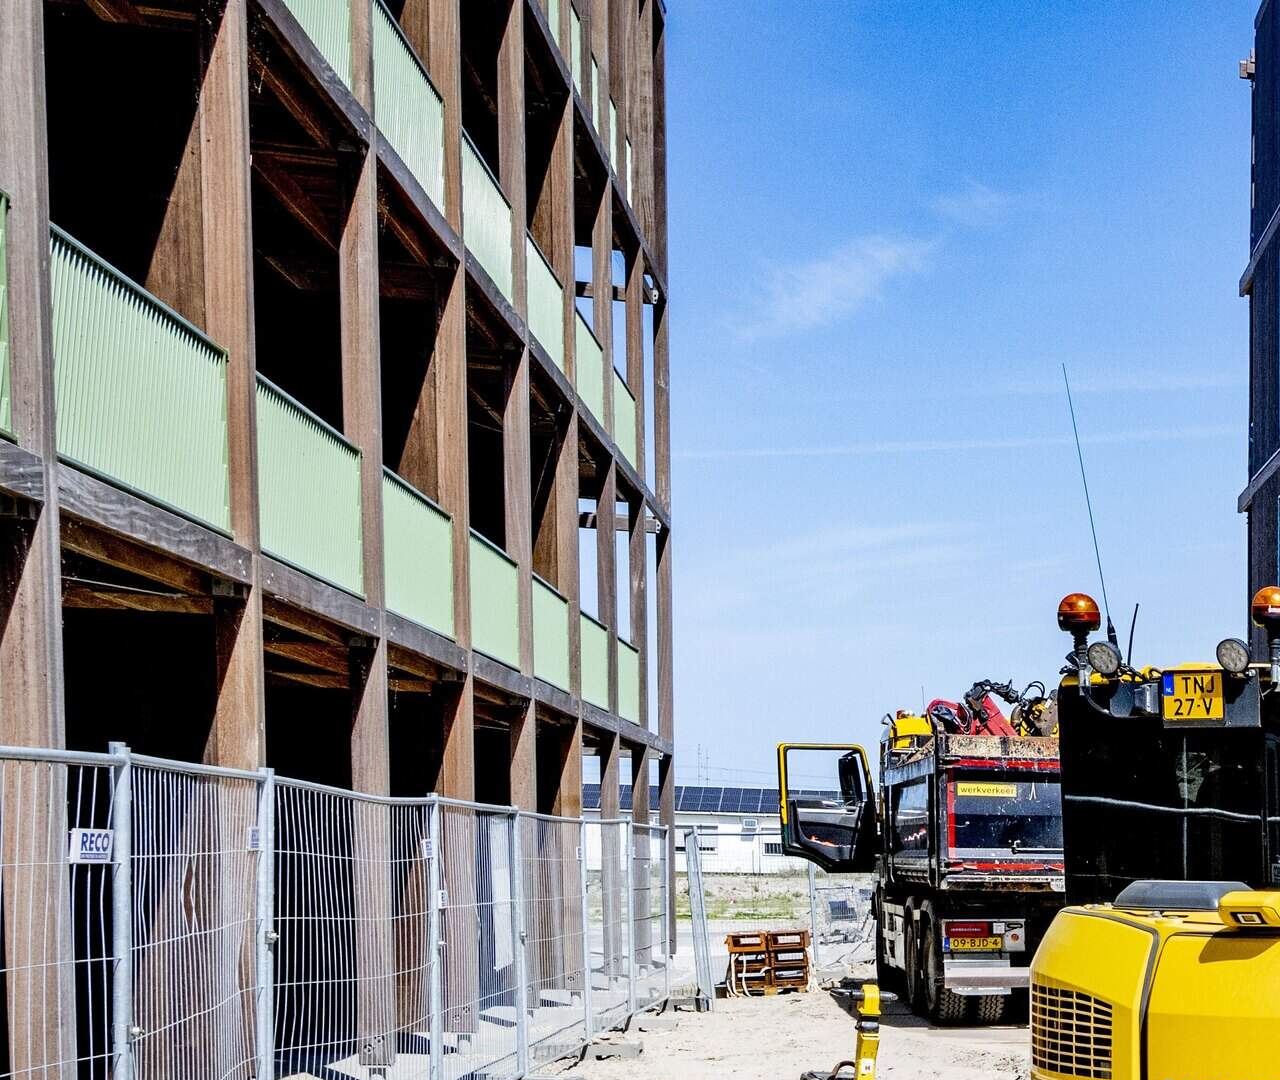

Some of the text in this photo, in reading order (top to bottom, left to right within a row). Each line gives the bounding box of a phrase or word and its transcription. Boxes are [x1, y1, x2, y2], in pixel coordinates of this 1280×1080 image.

[1181, 676, 1215, 694] TNJ
[1173, 697, 1213, 716] 27-V
[960, 786, 1014, 795] werkverkeer
[81, 832, 110, 852] RECO
[953, 938, 999, 948] 09-BJD-4
